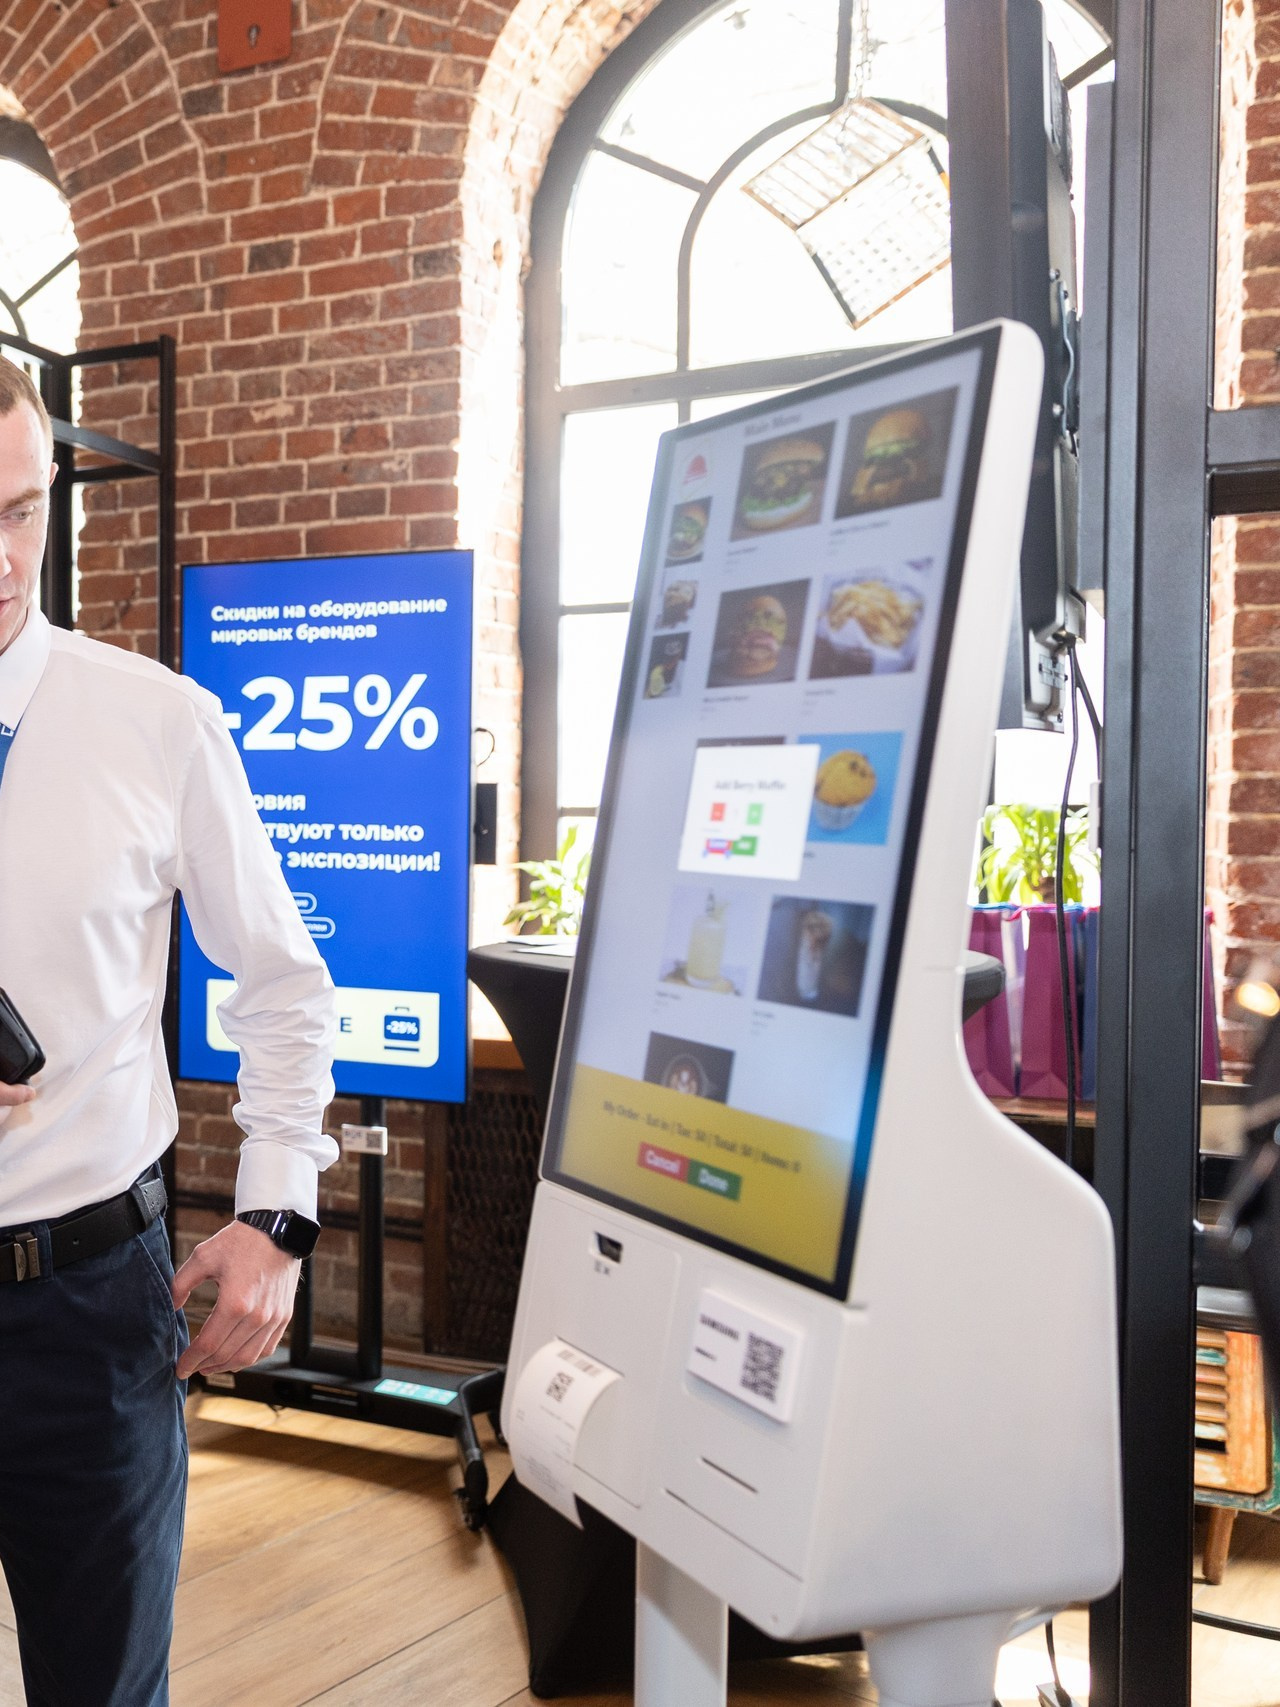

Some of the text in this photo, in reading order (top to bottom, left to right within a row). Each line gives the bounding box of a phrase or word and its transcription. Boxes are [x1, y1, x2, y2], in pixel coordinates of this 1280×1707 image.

[211, 598, 447, 622] Скидки на оборудование
[211, 622, 377, 645] мировых брендов
[253, 794, 306, 811] овия
[265, 822, 424, 844] твуют только
[287, 851, 441, 873] экспозиции!
